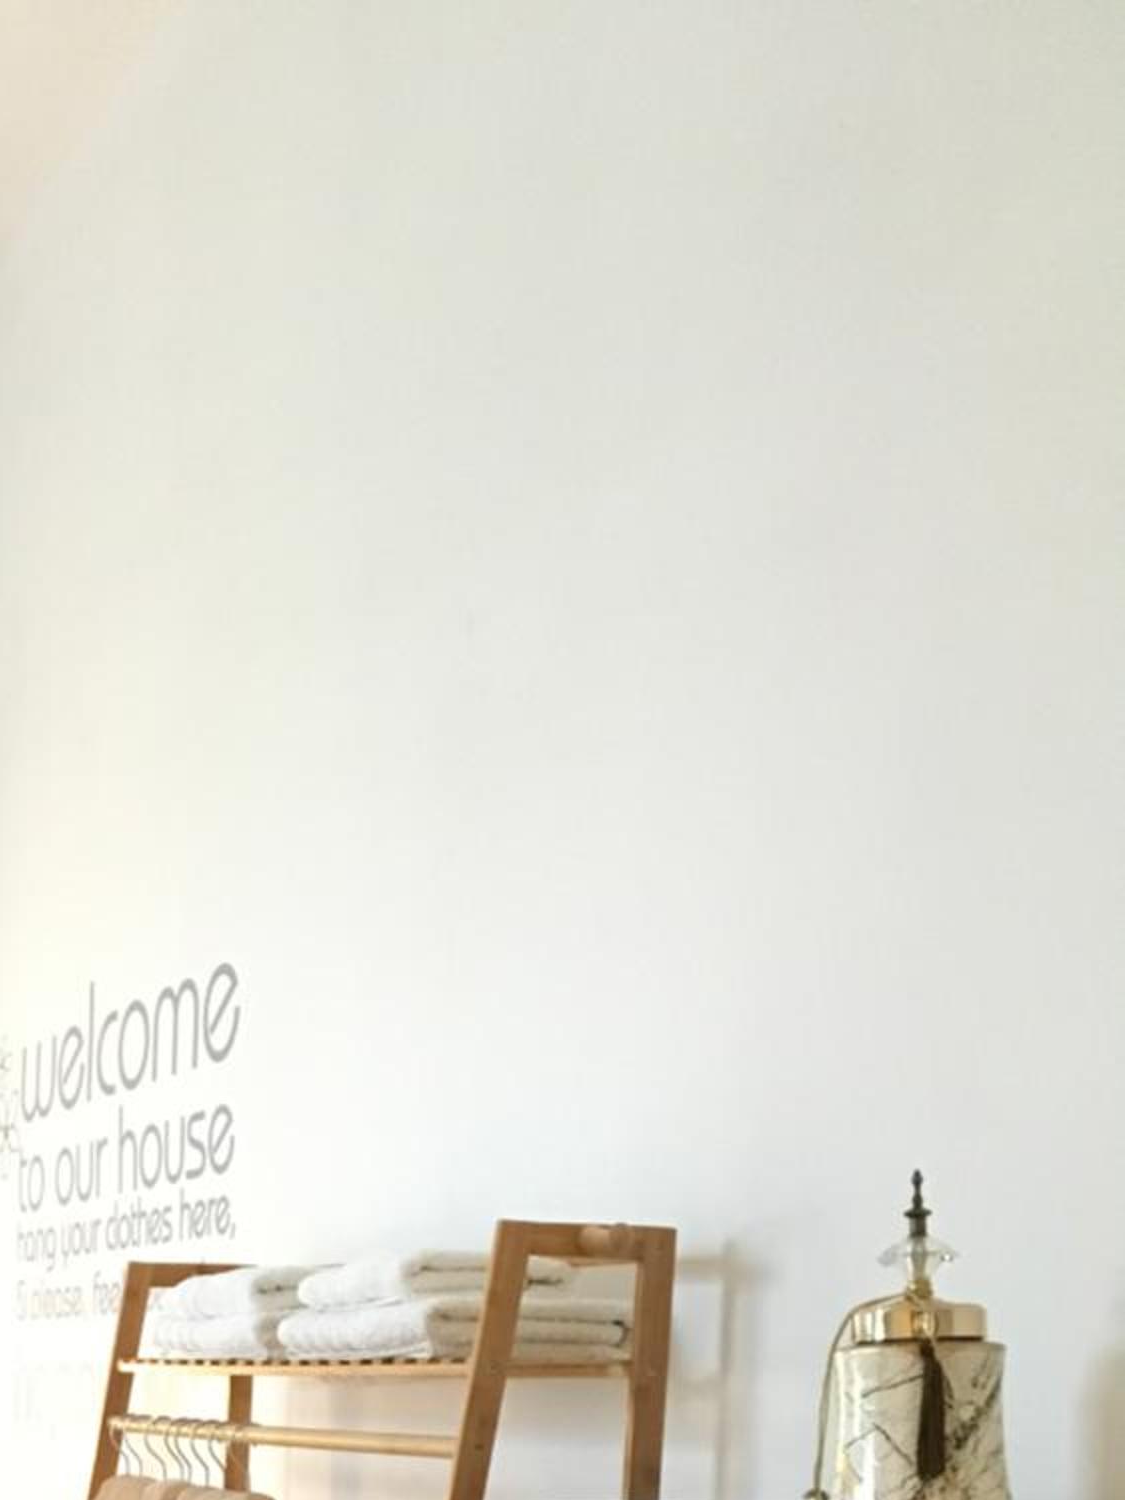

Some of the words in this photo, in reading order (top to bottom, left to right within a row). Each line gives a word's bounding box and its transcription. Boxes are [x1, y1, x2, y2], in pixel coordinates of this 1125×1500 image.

[19, 963, 241, 1123] welcome
[18, 1146, 45, 1213] to
[55, 1136, 108, 1208] our
[118, 1104, 236, 1195] house
[60, 1217, 102, 1269] your
[105, 1197, 173, 1251] clothes
[180, 1187, 236, 1241] here,
